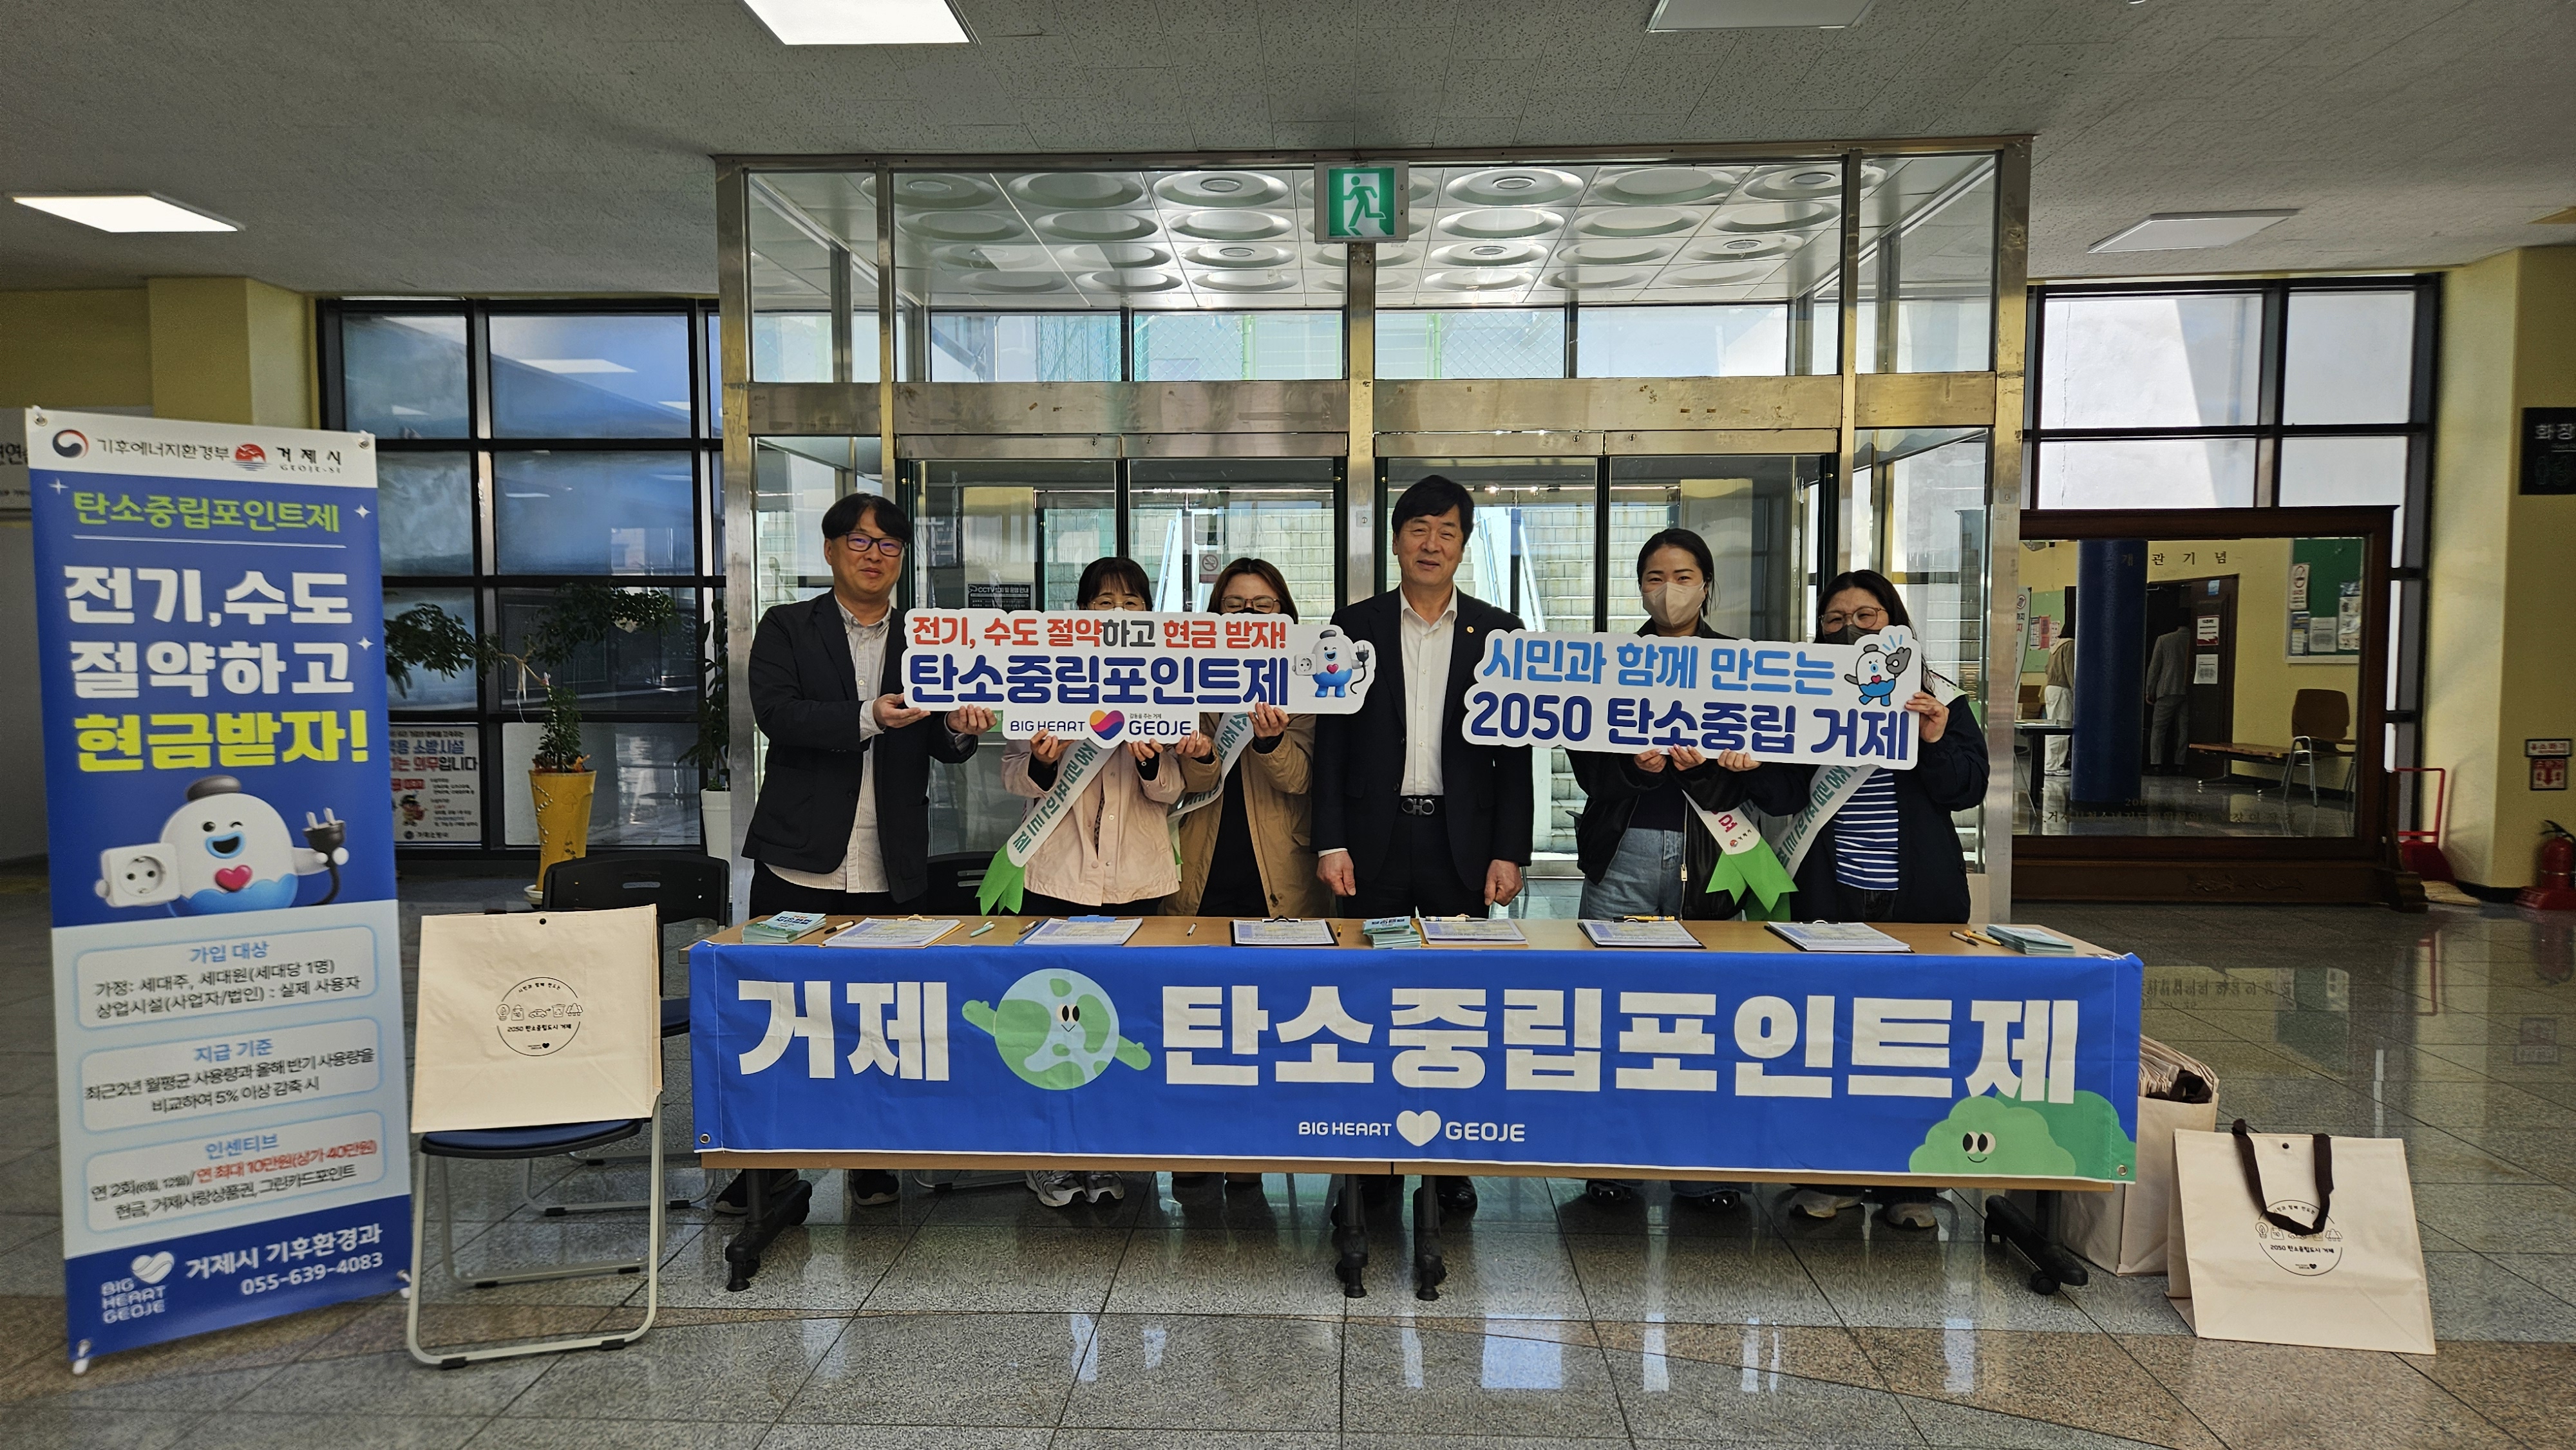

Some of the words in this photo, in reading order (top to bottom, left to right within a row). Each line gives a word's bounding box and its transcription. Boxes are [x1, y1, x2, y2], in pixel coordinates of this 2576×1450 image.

[95, 438, 230, 461] 기후에너지환경부
[73, 492, 340, 533] 탄소중립포인트제
[64, 565, 354, 628] 전기,수도
[912, 616, 976, 648] 전기,
[983, 617, 1039, 646] 수도
[1046, 617, 1156, 648] 절약하고
[1164, 619, 1218, 648] 현금
[1226, 620, 1287, 649] 받자!
[70, 641, 355, 700] 절약하고
[909, 654, 1289, 706] 탄소중립포인트제
[1482, 637, 1607, 686] 시민과
[1616, 642, 1698, 690] 함께
[1710, 648, 1835, 696] 만드는
[73, 709, 369, 773] 현금받자!
[1010, 720, 1034, 732] BIG
[1037, 720, 1086, 732] HEART
[1128, 720, 1192, 736] GEOJE
[1470, 692, 1592, 742] 2050
[1608, 697, 1795, 755] 탄소중립
[1810, 708, 1910, 761] 거제
[1012, 740, 1099, 854] 중립포인트제
[1777, 766, 1860, 868] 중립포인트제
[189, 945, 226, 964] 가입
[232, 941, 269, 959] 대상
[95, 980, 134, 997] 가정:
[140, 974, 194, 992] 세대주,
[198, 962, 301, 986] 세대원(세대당
[307, 958, 336, 975] 1명)
[96, 986, 265, 1020] 상업시설(사업자/법인)
[279, 980, 311, 999] 실제
[314, 975, 361, 993] 사용자
[194, 1044, 232, 1063] 지급
[236, 1039, 274, 1057] 기준
[738, 979, 950, 1082] 거제
[1162, 984, 2079, 1105] 탄소중립포인트제
[145, 1072, 191, 1093] 월평균
[194, 1062, 253, 1085] 사용량과
[254, 1060, 287, 1076] 올해
[287, 1055, 316, 1073] 반기
[319, 1047, 375, 1068] 사용량을
[151, 1091, 213, 1113] 비교하여
[215, 1088, 240, 1104] 5%
[242, 1084, 272, 1100] 이상
[274, 1078, 302, 1097] 감축
[304, 1075, 320, 1091] 시
[205, 1133, 279, 1160] 인센티브
[1299, 1122, 1329, 1136] BIG
[1332, 1122, 1392, 1137] HEART
[1446, 1122, 1526, 1142] GEOJE
[91, 1185, 108, 1201] 연
[215, 1162, 245, 1180] 최대
[115, 1200, 151, 1221] 현금,
[259, 1164, 357, 1193] 그린카드포인트
[185, 1247, 259, 1280] 거제시
[265, 1223, 383, 1264] 기후환경과
[101, 1278, 136, 1297] BIG
[240, 1252, 384, 1295] 055-639-4083
[101, 1285, 167, 1310] HEART
[102, 1299, 166, 1324] GEOJE
